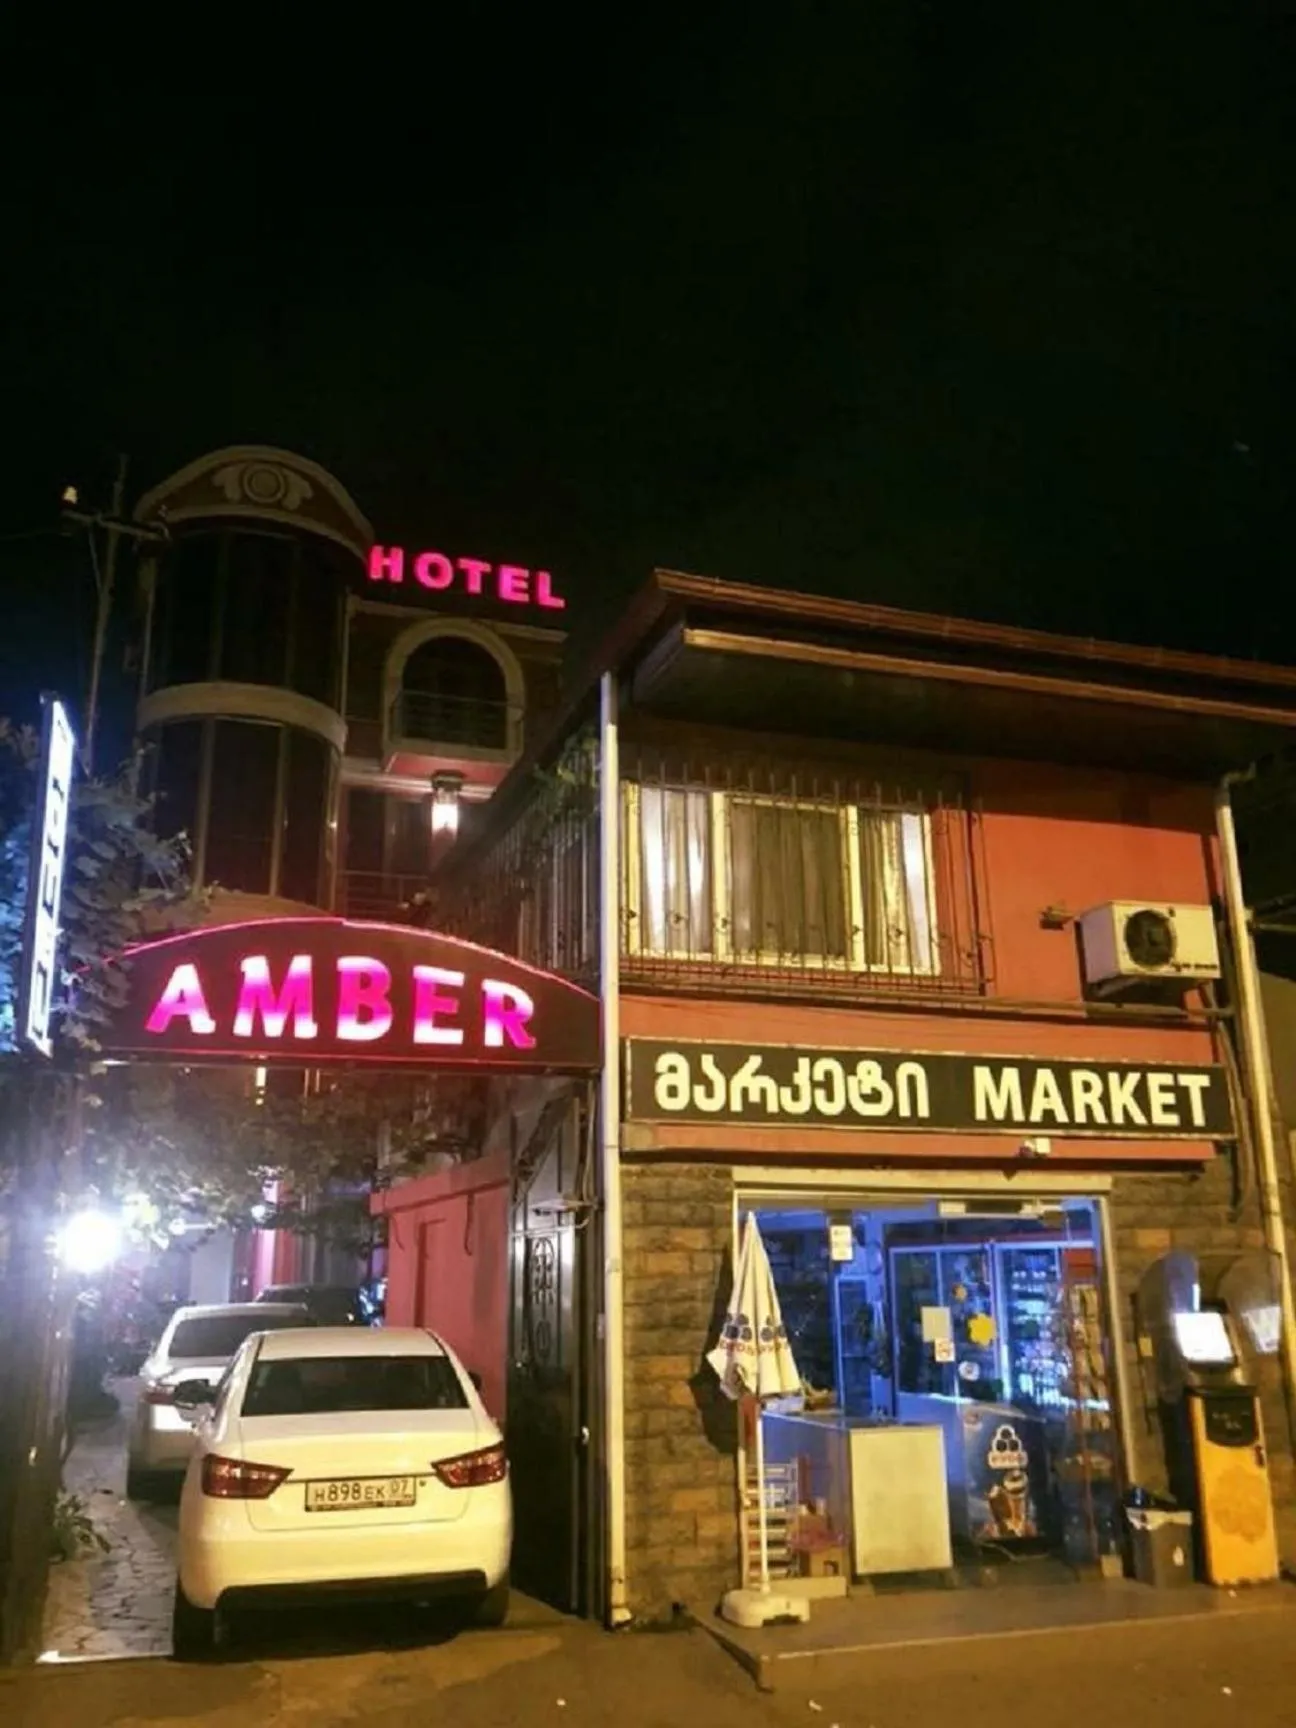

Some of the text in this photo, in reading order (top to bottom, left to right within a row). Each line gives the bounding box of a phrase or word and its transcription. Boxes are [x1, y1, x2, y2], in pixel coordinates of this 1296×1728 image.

[369, 545, 565, 608] HOTEL
[145, 955, 536, 1048] AMBER
[654, 1051, 929, 1118] მარკეტი
[974, 1065, 1210, 1127] MARKET
